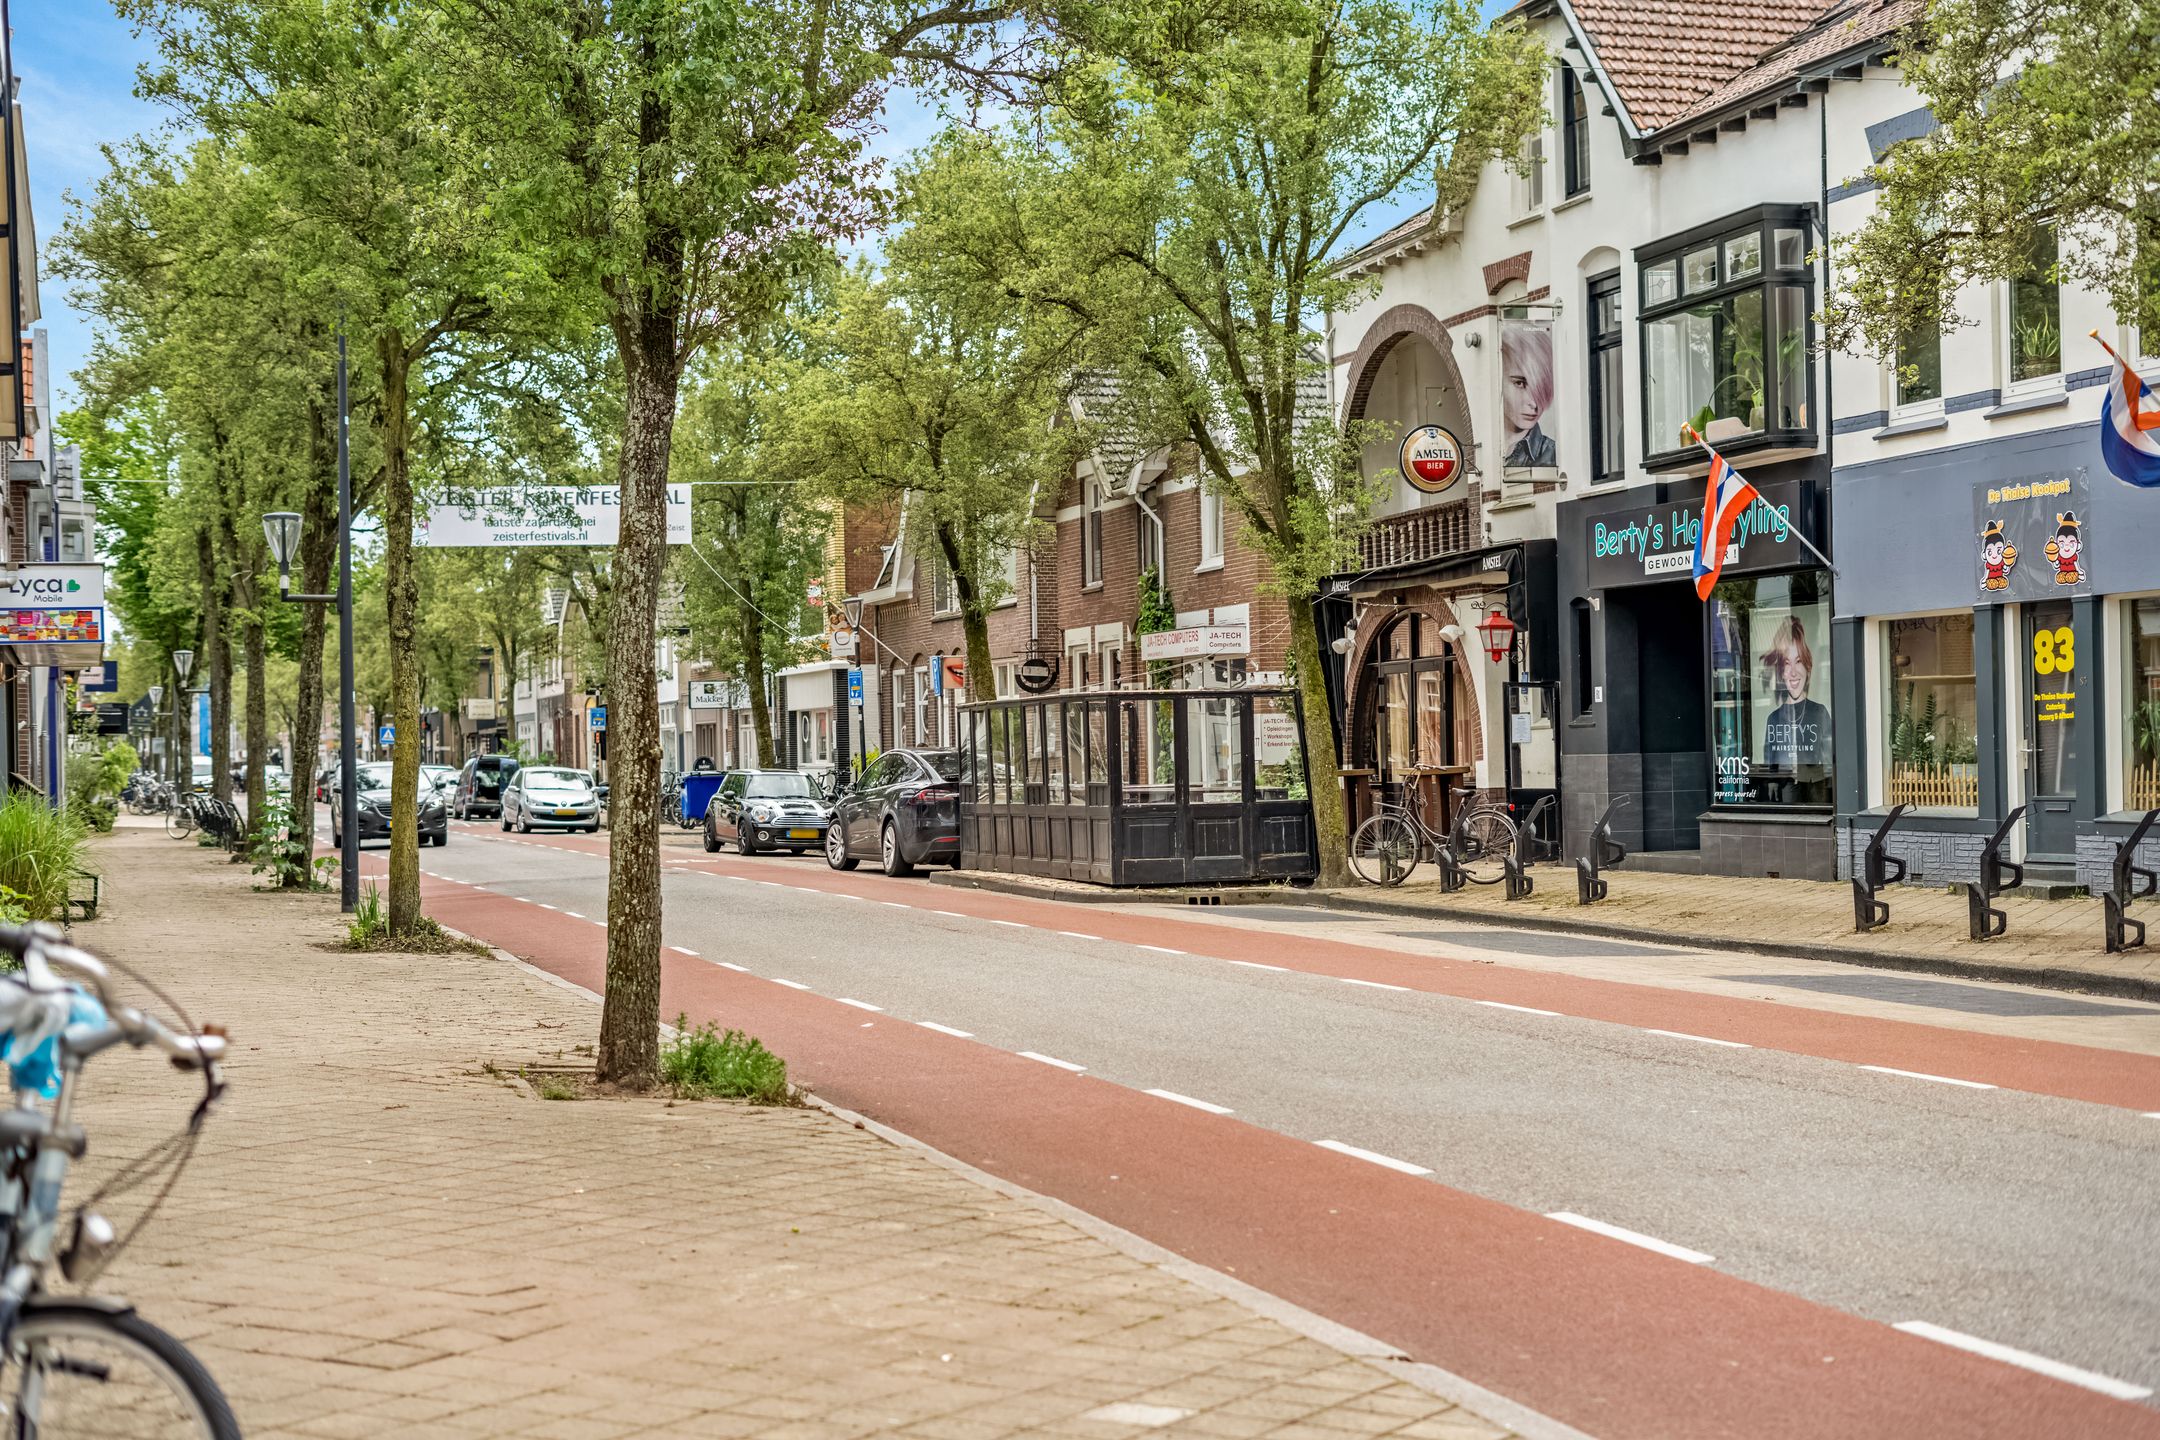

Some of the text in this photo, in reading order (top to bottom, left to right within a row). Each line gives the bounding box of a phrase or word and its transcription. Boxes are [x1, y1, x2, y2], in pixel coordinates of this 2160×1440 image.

[1415, 449, 1453, 459] AMSTEL
[434, 491, 515, 506] ZETER
[492, 530, 588, 541] zeisterfestivals.nl
[1595, 498, 1790, 562] Berty's Hayling
[1483, 555, 1501, 570] AMSTEL
[1648, 555, 1691, 570] GEWOON
[33, 595, 63, 603] Mobile
[1147, 630, 1199, 648] JA-TECH COMPUTERS
[2034, 626, 2075, 675] 83
[696, 695, 724, 704] Makker
[1767, 724, 1818, 743] BERTY'S
[1718, 775, 1749, 785] california
[1714, 789, 1757, 801] express yourself
